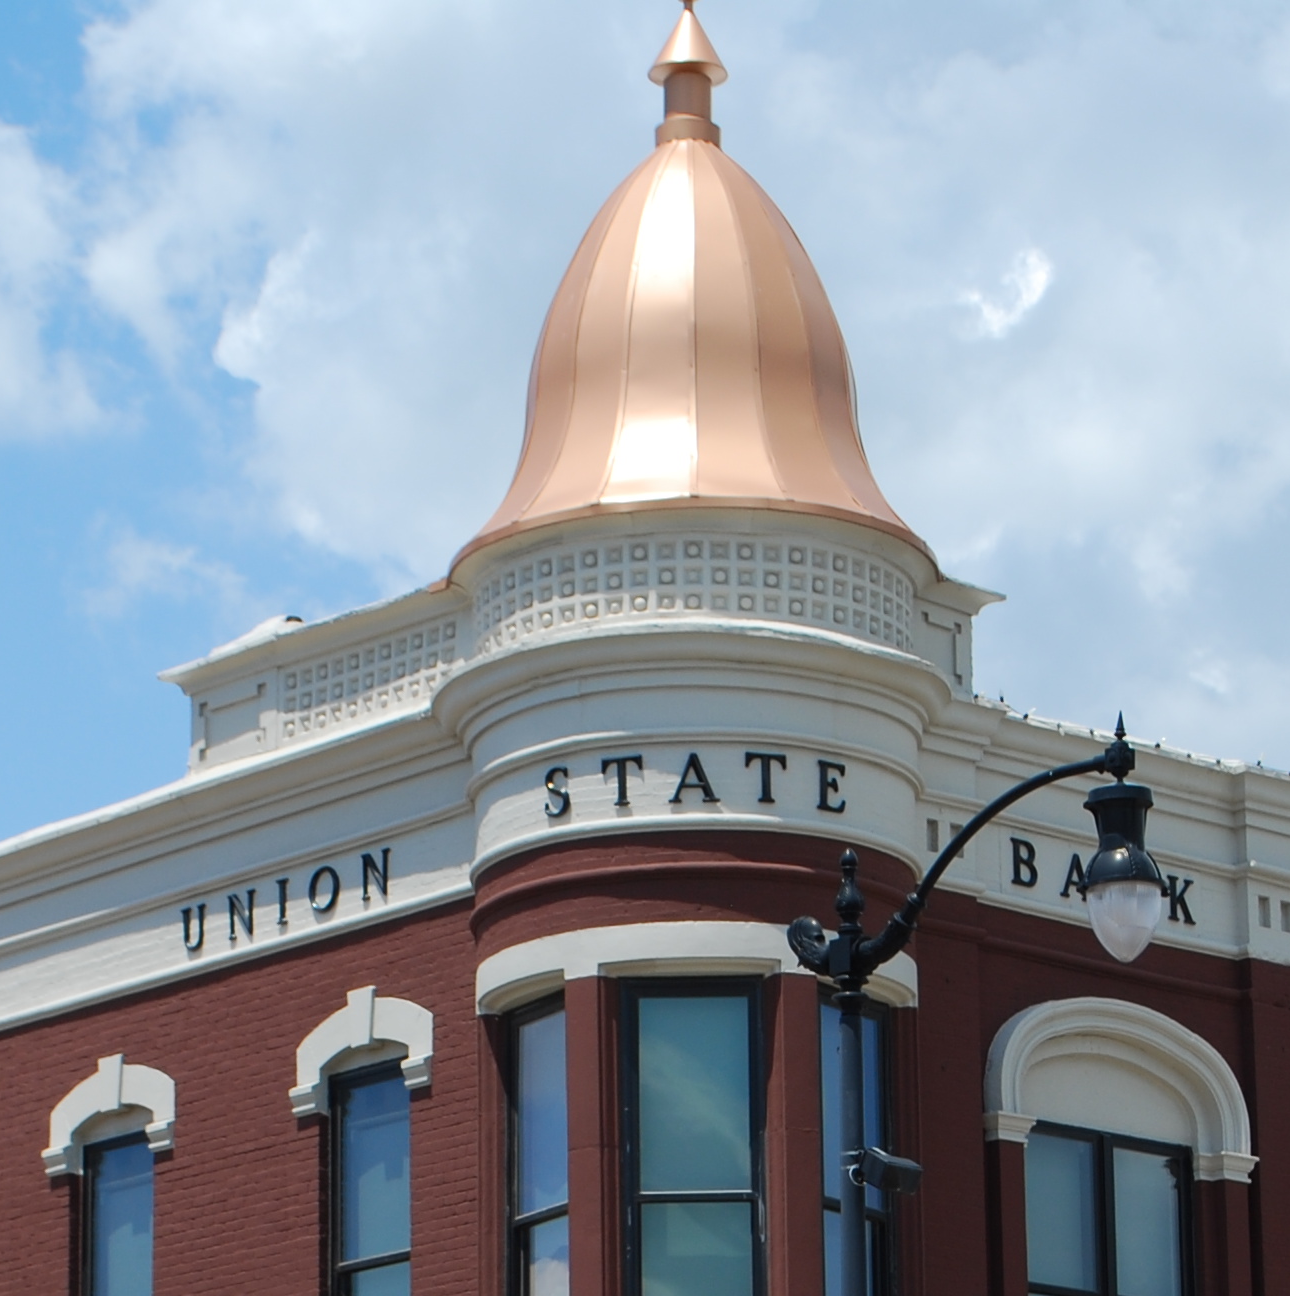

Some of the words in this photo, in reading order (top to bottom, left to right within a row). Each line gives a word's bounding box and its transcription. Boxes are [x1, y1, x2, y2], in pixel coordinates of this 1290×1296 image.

[543, 751, 847, 818] STATE
[181, 847, 391, 952] UNION
[1010, 836, 1197, 925] BAK
